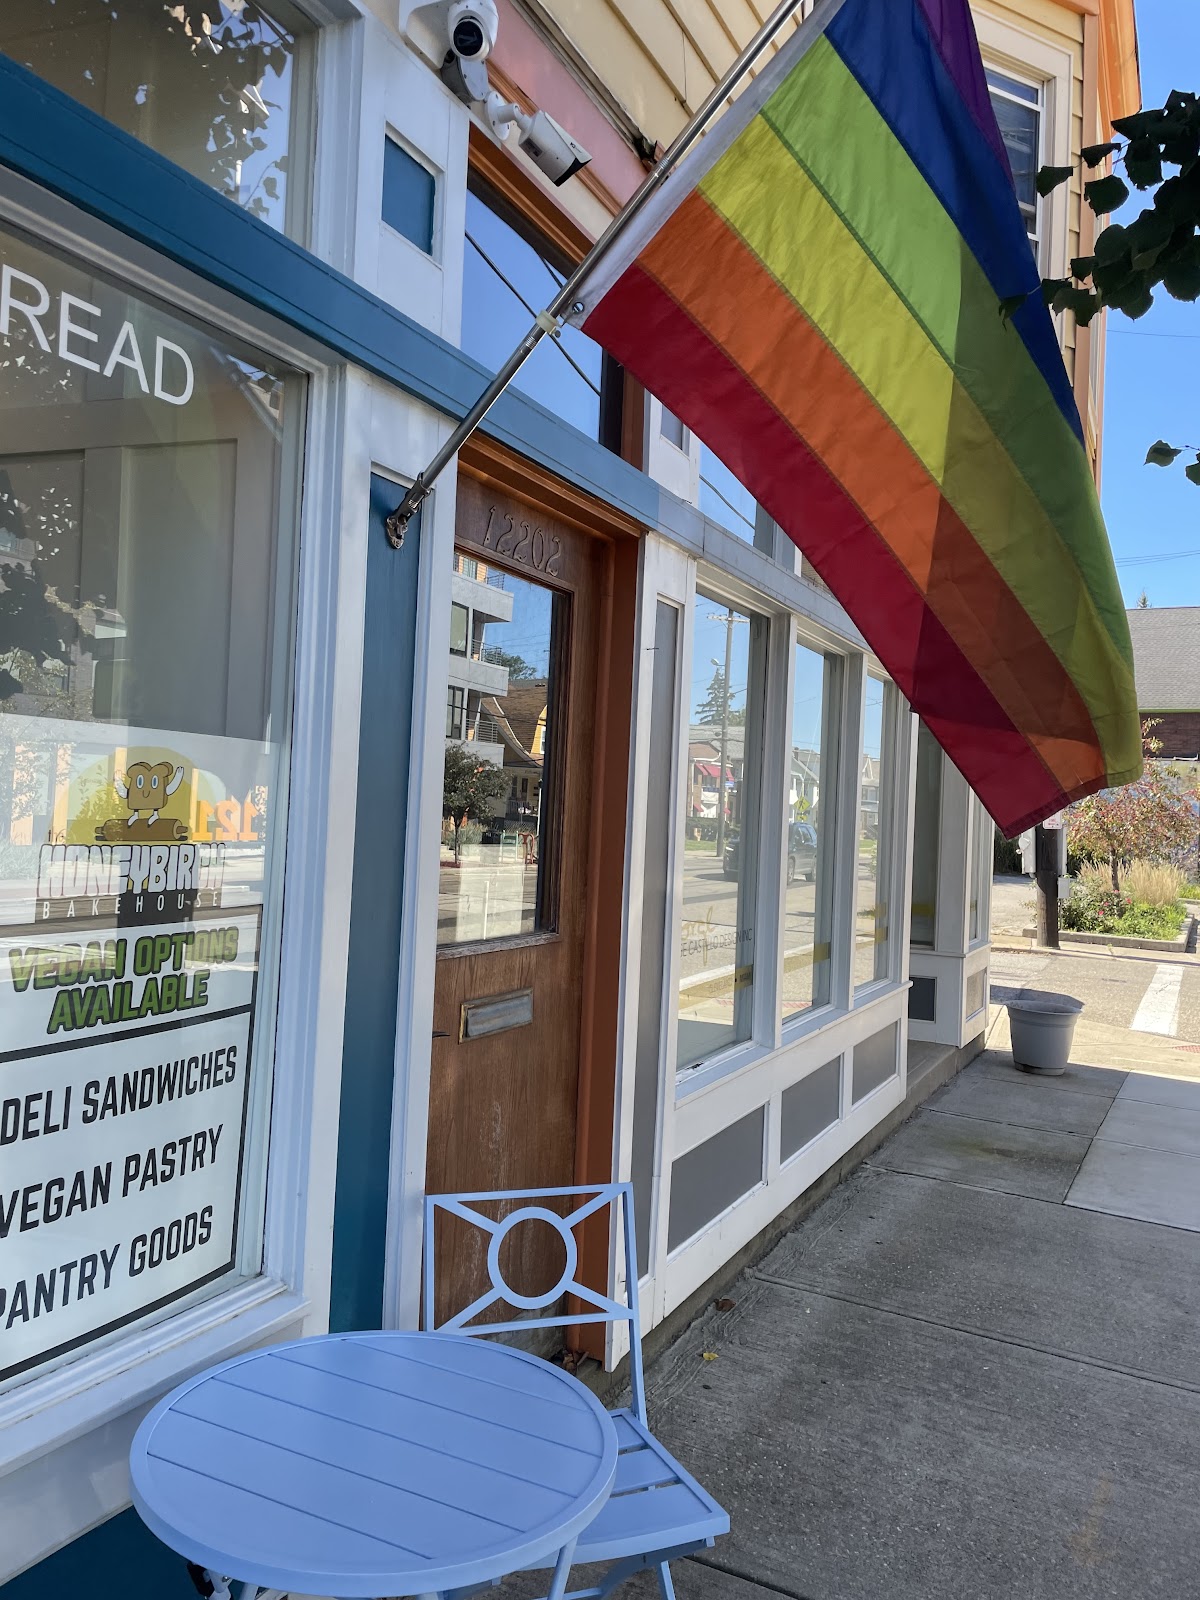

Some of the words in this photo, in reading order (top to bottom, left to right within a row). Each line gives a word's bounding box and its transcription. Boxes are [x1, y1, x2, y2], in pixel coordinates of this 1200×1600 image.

[0, 264, 194, 405] READ
[483, 505, 561, 577] 12202
[42, 891, 218, 920] BAKEHOUSE
[8, 938, 127, 992] VEGAN
[133, 926, 240, 976] OPTIONS
[46, 969, 210, 1034] AVAILABLE
[0, 1086, 72, 1146] DELI
[82, 1046, 237, 1124] SANDWICHES
[0, 1161, 112, 1239] VEGAN
[122, 1124, 223, 1198] PASTRY
[128, 1205, 213, 1278] GOODS
